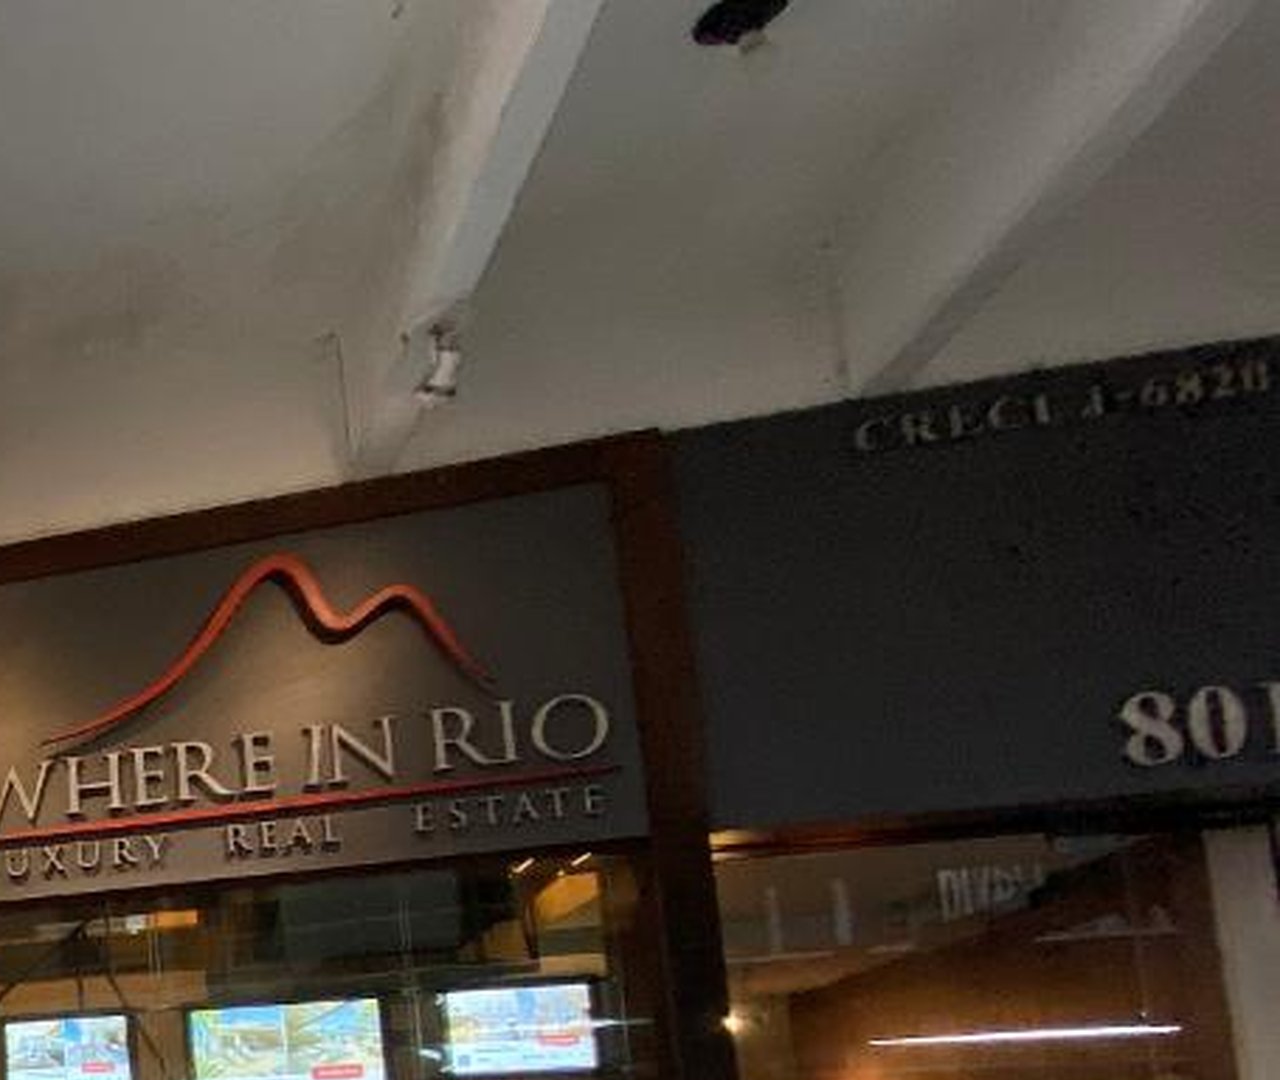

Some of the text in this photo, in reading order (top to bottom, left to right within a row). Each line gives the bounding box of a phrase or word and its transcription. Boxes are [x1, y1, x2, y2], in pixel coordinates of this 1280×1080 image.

[302, 714, 397, 790] IN
[431, 694, 610, 772] RIO
[227, 814, 342, 853] REAL
[411, 784, 607, 833] ESTATE
